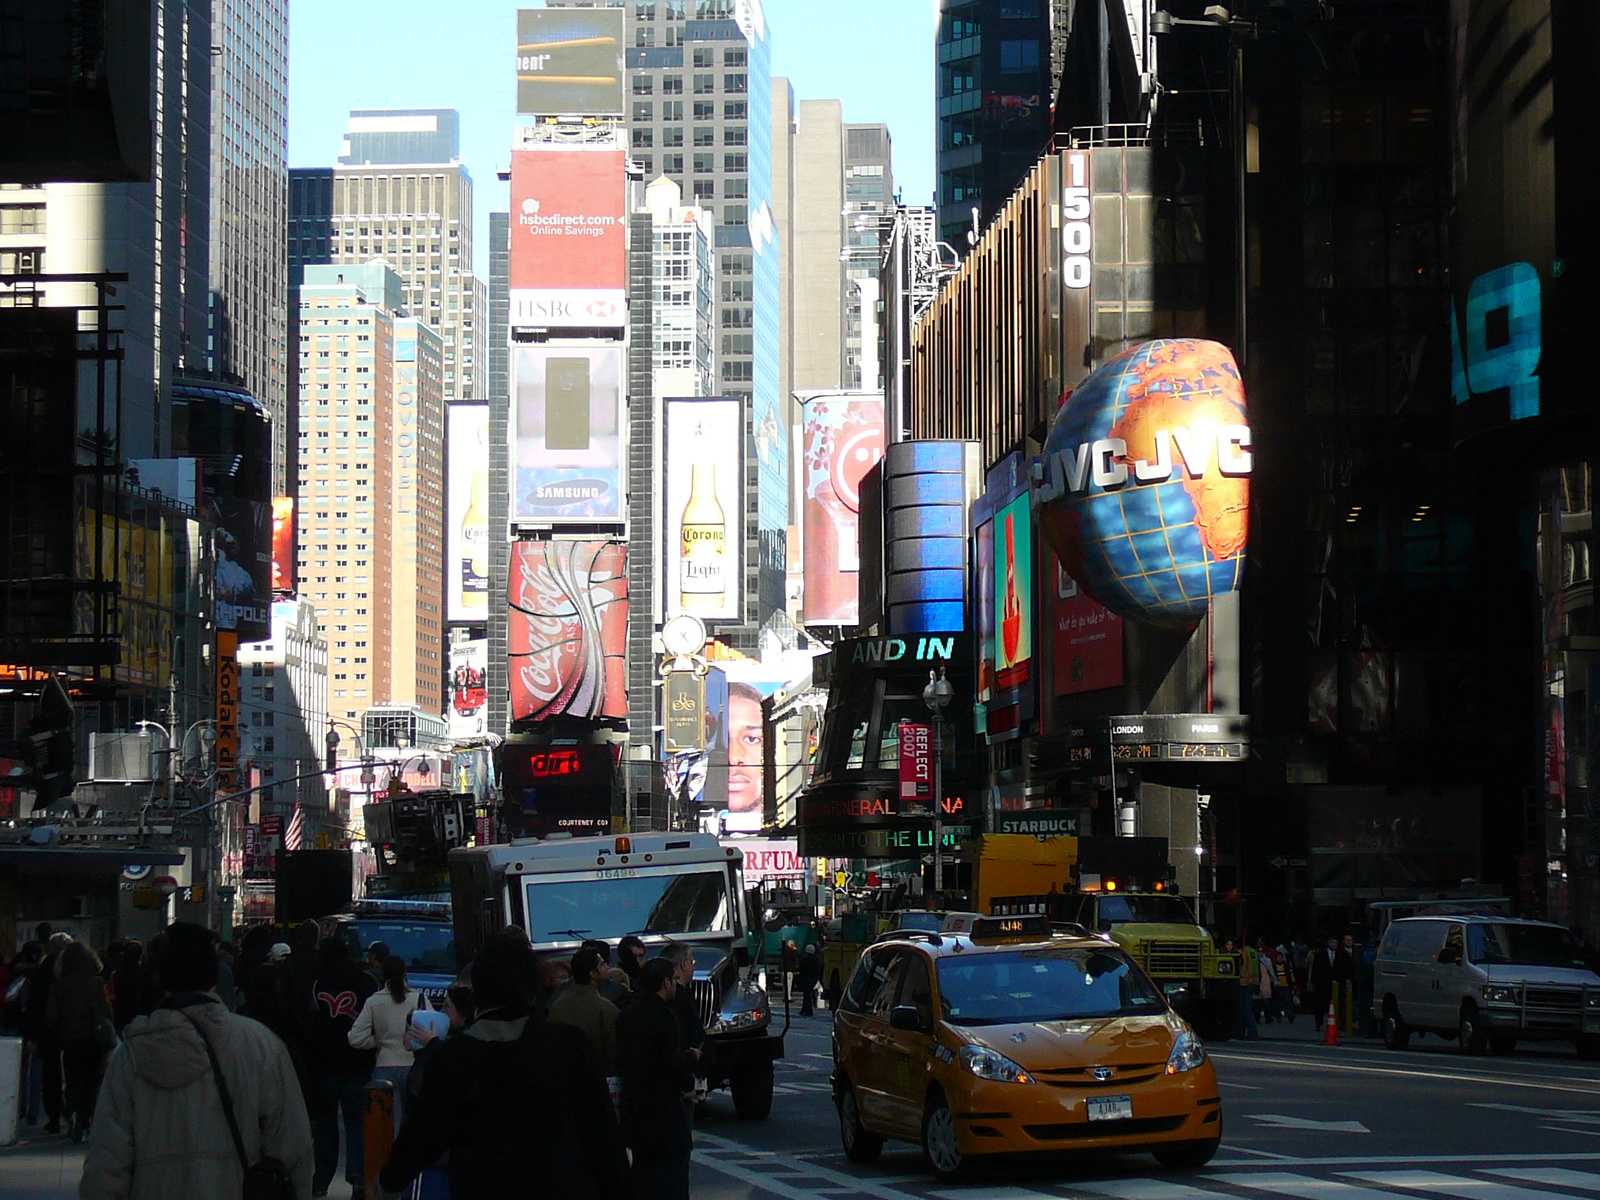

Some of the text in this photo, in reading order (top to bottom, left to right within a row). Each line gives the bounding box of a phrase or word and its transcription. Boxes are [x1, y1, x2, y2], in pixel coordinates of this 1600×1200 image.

[520, 214, 615, 225] hsbcdirect.com
[1063, 154, 1091, 289] 1500
[530, 226, 605, 237] Online Savings
[519, 300, 576, 318] HSBC
[397, 368, 413, 514] NOVOTEL
[1135, 425, 1253, 483] JVC
[1036, 438, 1128, 505] JVC
[536, 487, 599, 499] SAMSUNG
[682, 527, 724, 543] Corona
[686, 560, 721, 579] Light
[851, 636, 955, 664] AND IN
[220, 656, 234, 738] Kodak
[1112, 724, 1144, 734] LONDON
[1191, 723, 1219, 733] PARIS
[902, 727, 915, 758] 2007
[916, 727, 928, 780] REFLECT
[1002, 819, 1077, 834] STARBUCK
[872, 830, 912, 847] THE
[596, 868, 636, 879] 06496
[999, 920, 1024, 932] 4J48
